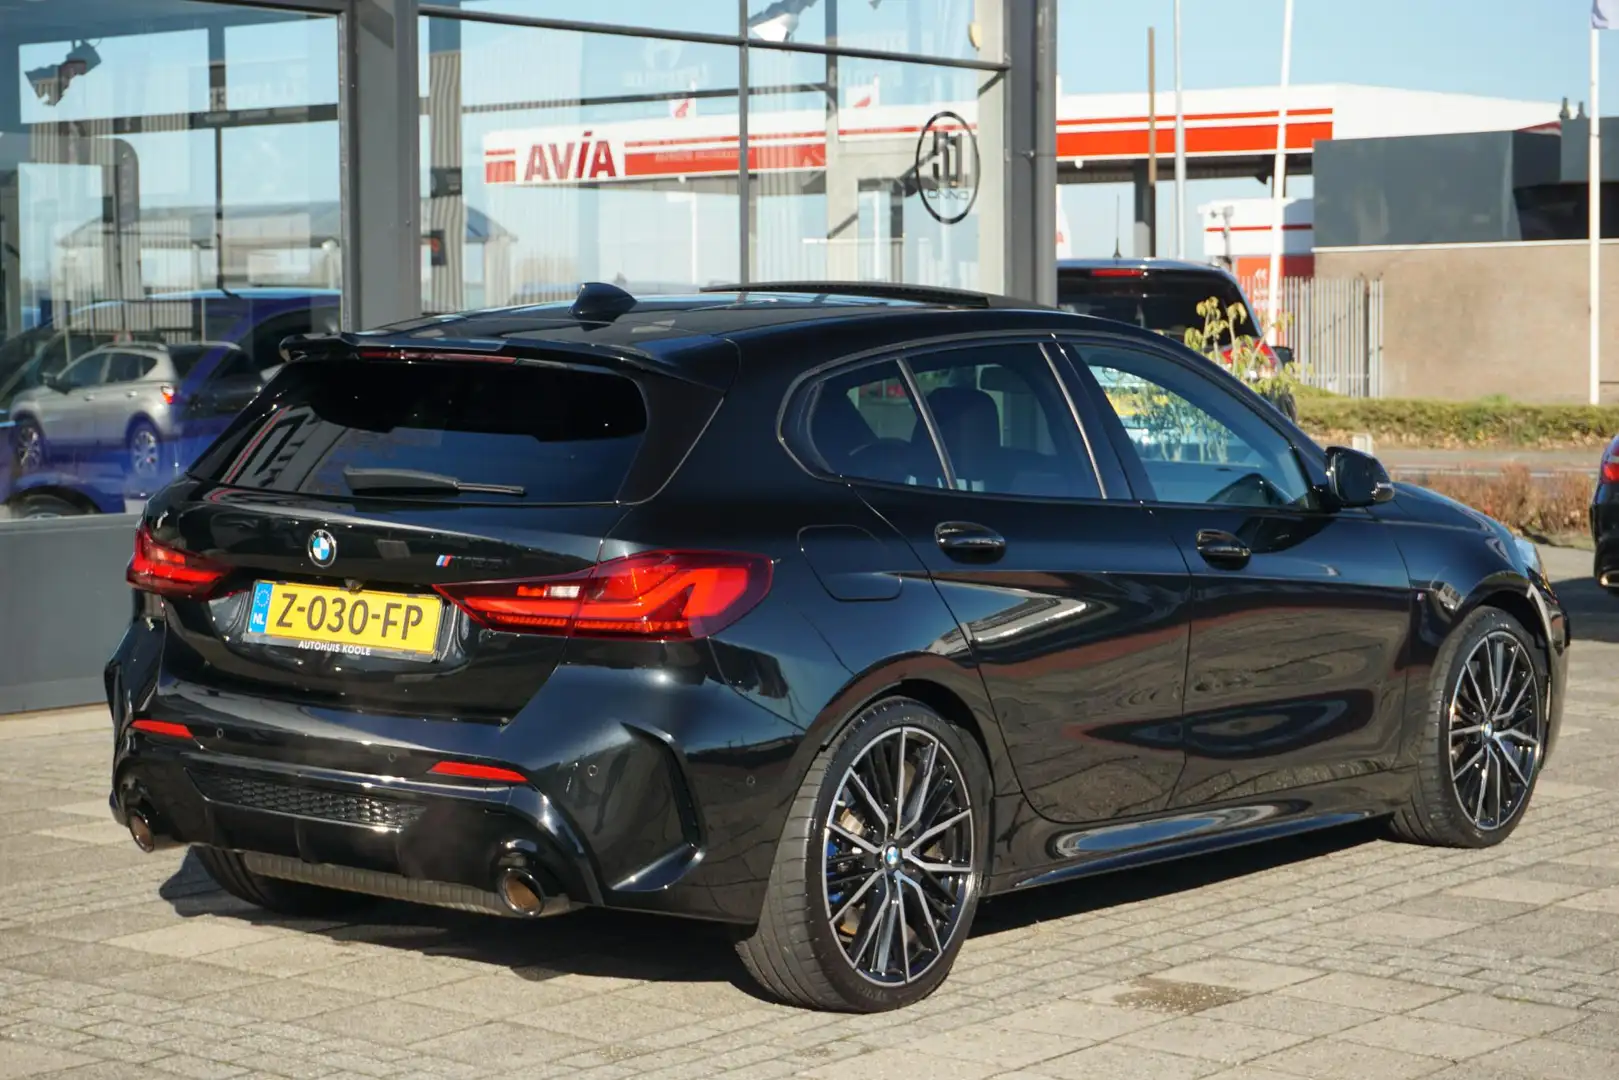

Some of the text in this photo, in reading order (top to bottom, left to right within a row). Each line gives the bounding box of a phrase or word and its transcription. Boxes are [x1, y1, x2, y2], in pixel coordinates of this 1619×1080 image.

[252, 612, 265, 626] NL
[276, 593, 423, 640] Z-030-FP
[298, 641, 371, 657] AUTOHUIS KOOLE
